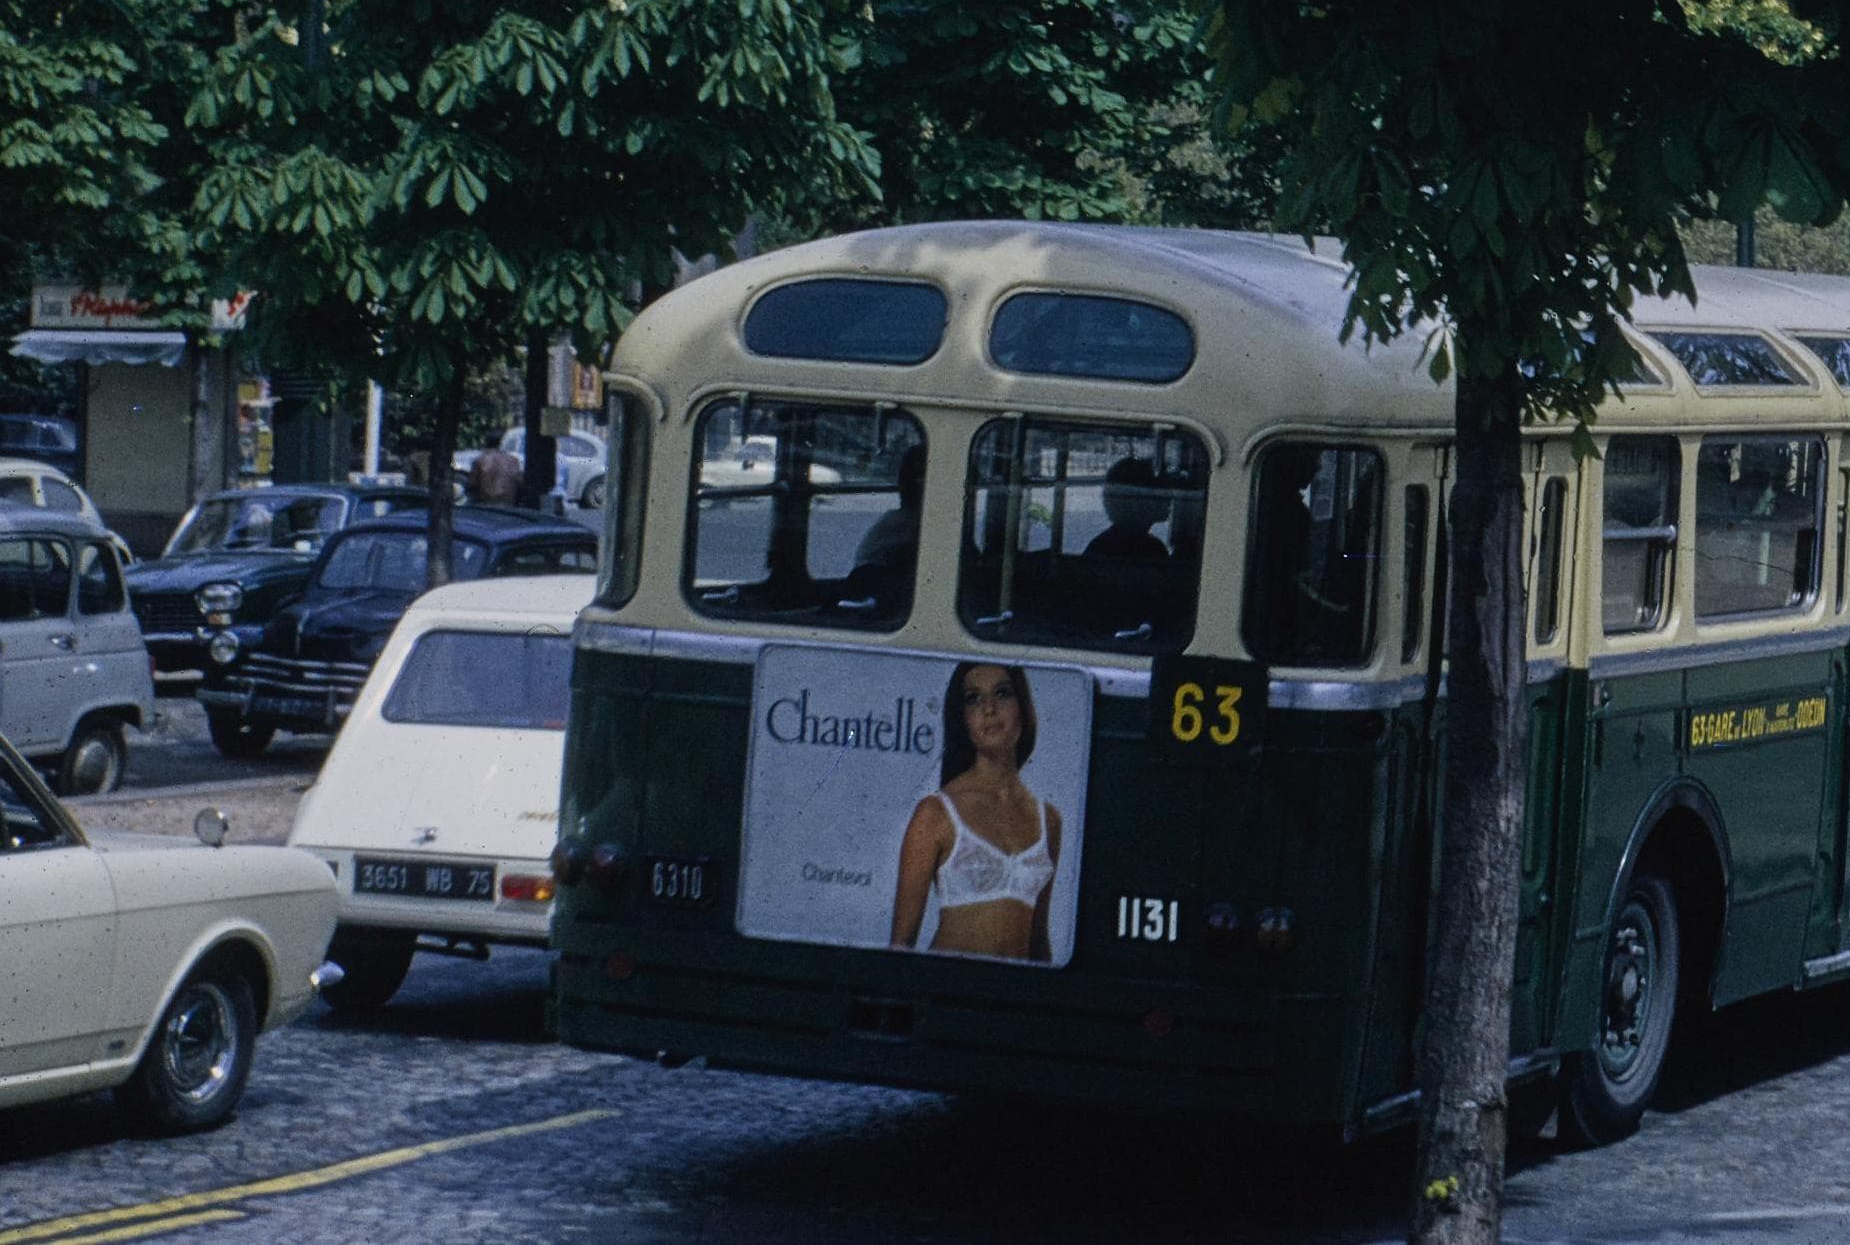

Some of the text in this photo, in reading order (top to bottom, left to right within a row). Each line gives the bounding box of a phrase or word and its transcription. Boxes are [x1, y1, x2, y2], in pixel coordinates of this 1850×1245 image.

[766, 688, 936, 755] Chantelle
[1172, 681, 1243, 746] 63
[361, 863, 491, 895] 3651 WB 75
[652, 861, 702, 900] 6310
[1117, 895, 1179, 943] 1131
